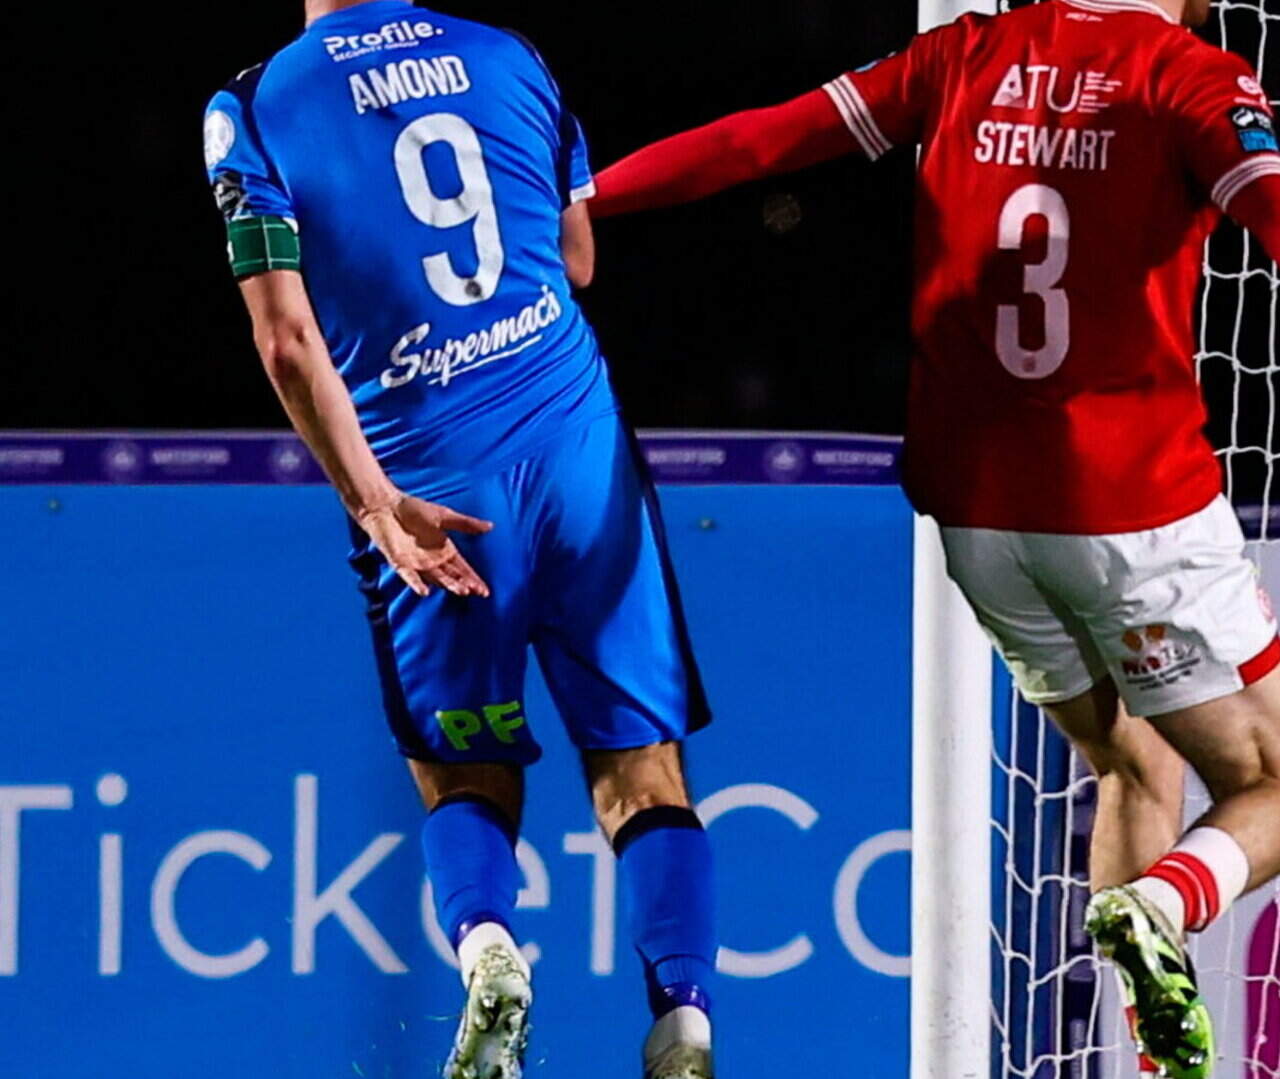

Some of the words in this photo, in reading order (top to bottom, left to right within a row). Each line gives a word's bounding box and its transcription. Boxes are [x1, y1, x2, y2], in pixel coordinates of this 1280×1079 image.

[348, 54, 471, 115] AMOND
[991, 63, 1082, 114] ATU
[974, 120, 1116, 171] STEWART
[394, 113, 504, 307] 9
[995, 183, 1071, 380] 3
[380, 284, 562, 388] Supermac's
